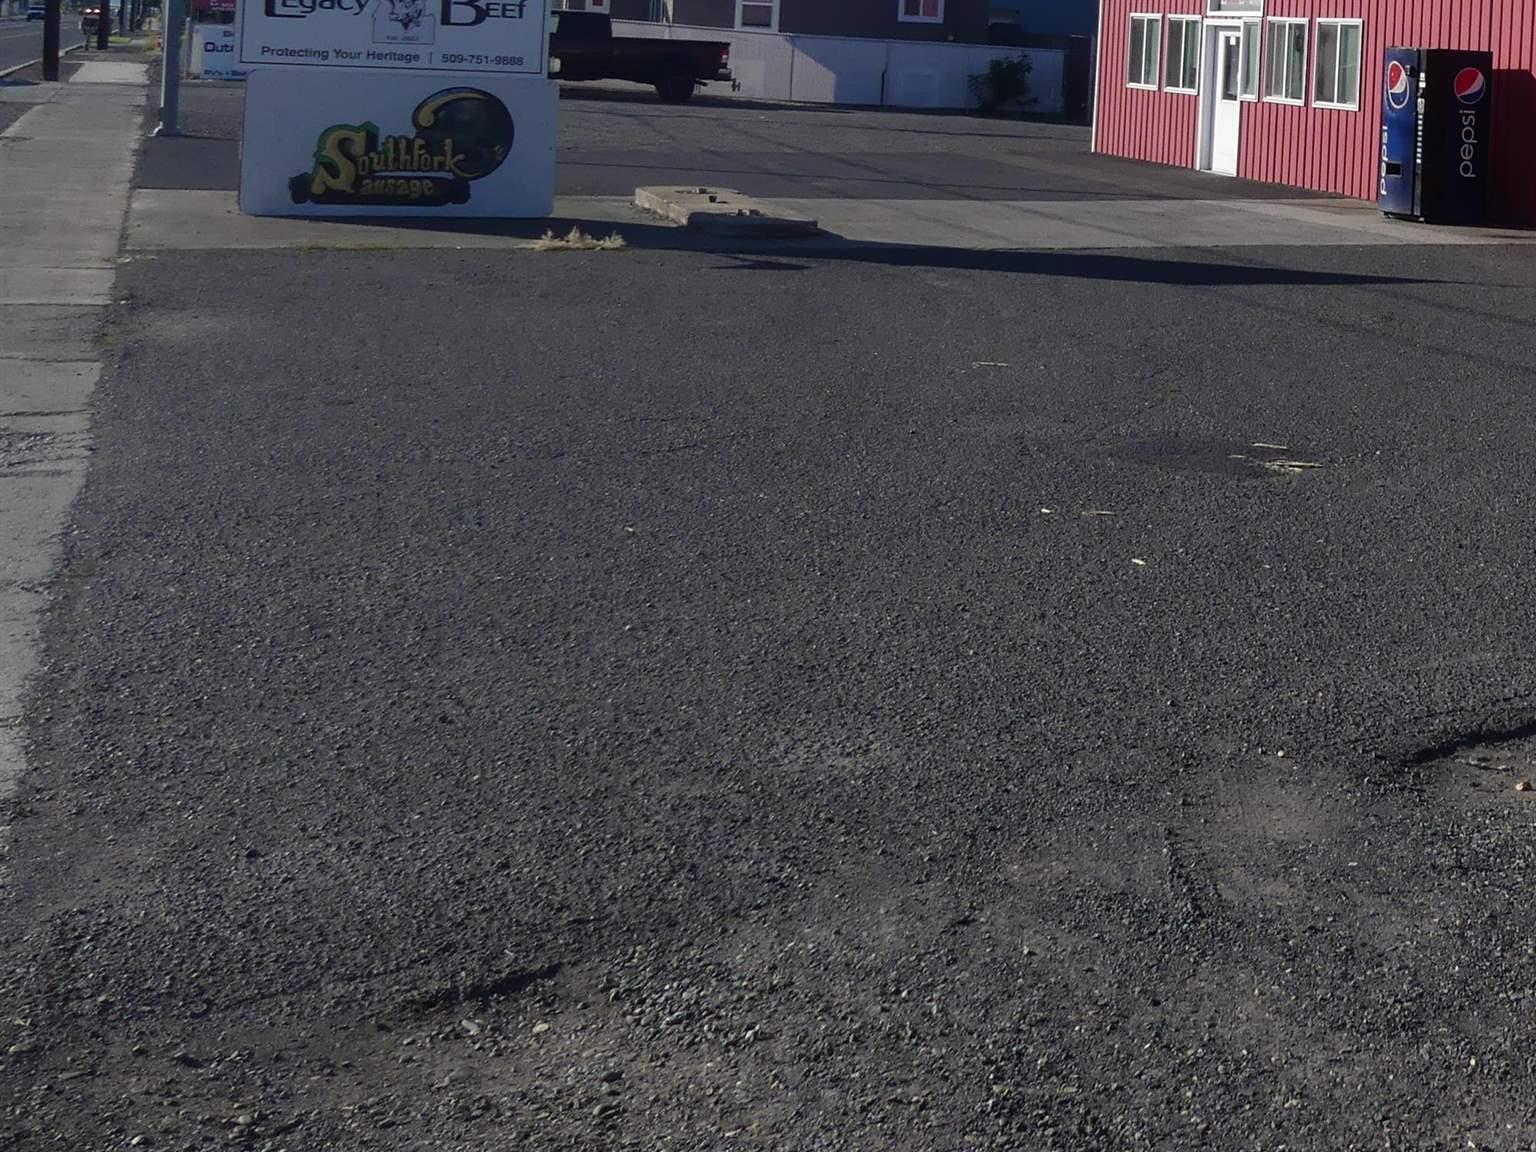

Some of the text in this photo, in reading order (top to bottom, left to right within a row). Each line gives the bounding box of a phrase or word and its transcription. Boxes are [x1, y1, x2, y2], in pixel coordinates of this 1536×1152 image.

[261, 46, 330, 61] Protecting
[333, 48, 362, 60] Your
[366, 50, 420, 64] Heritage
[1380, 125, 1389, 196] pepsi
[1459, 110, 1478, 178] pepsi
